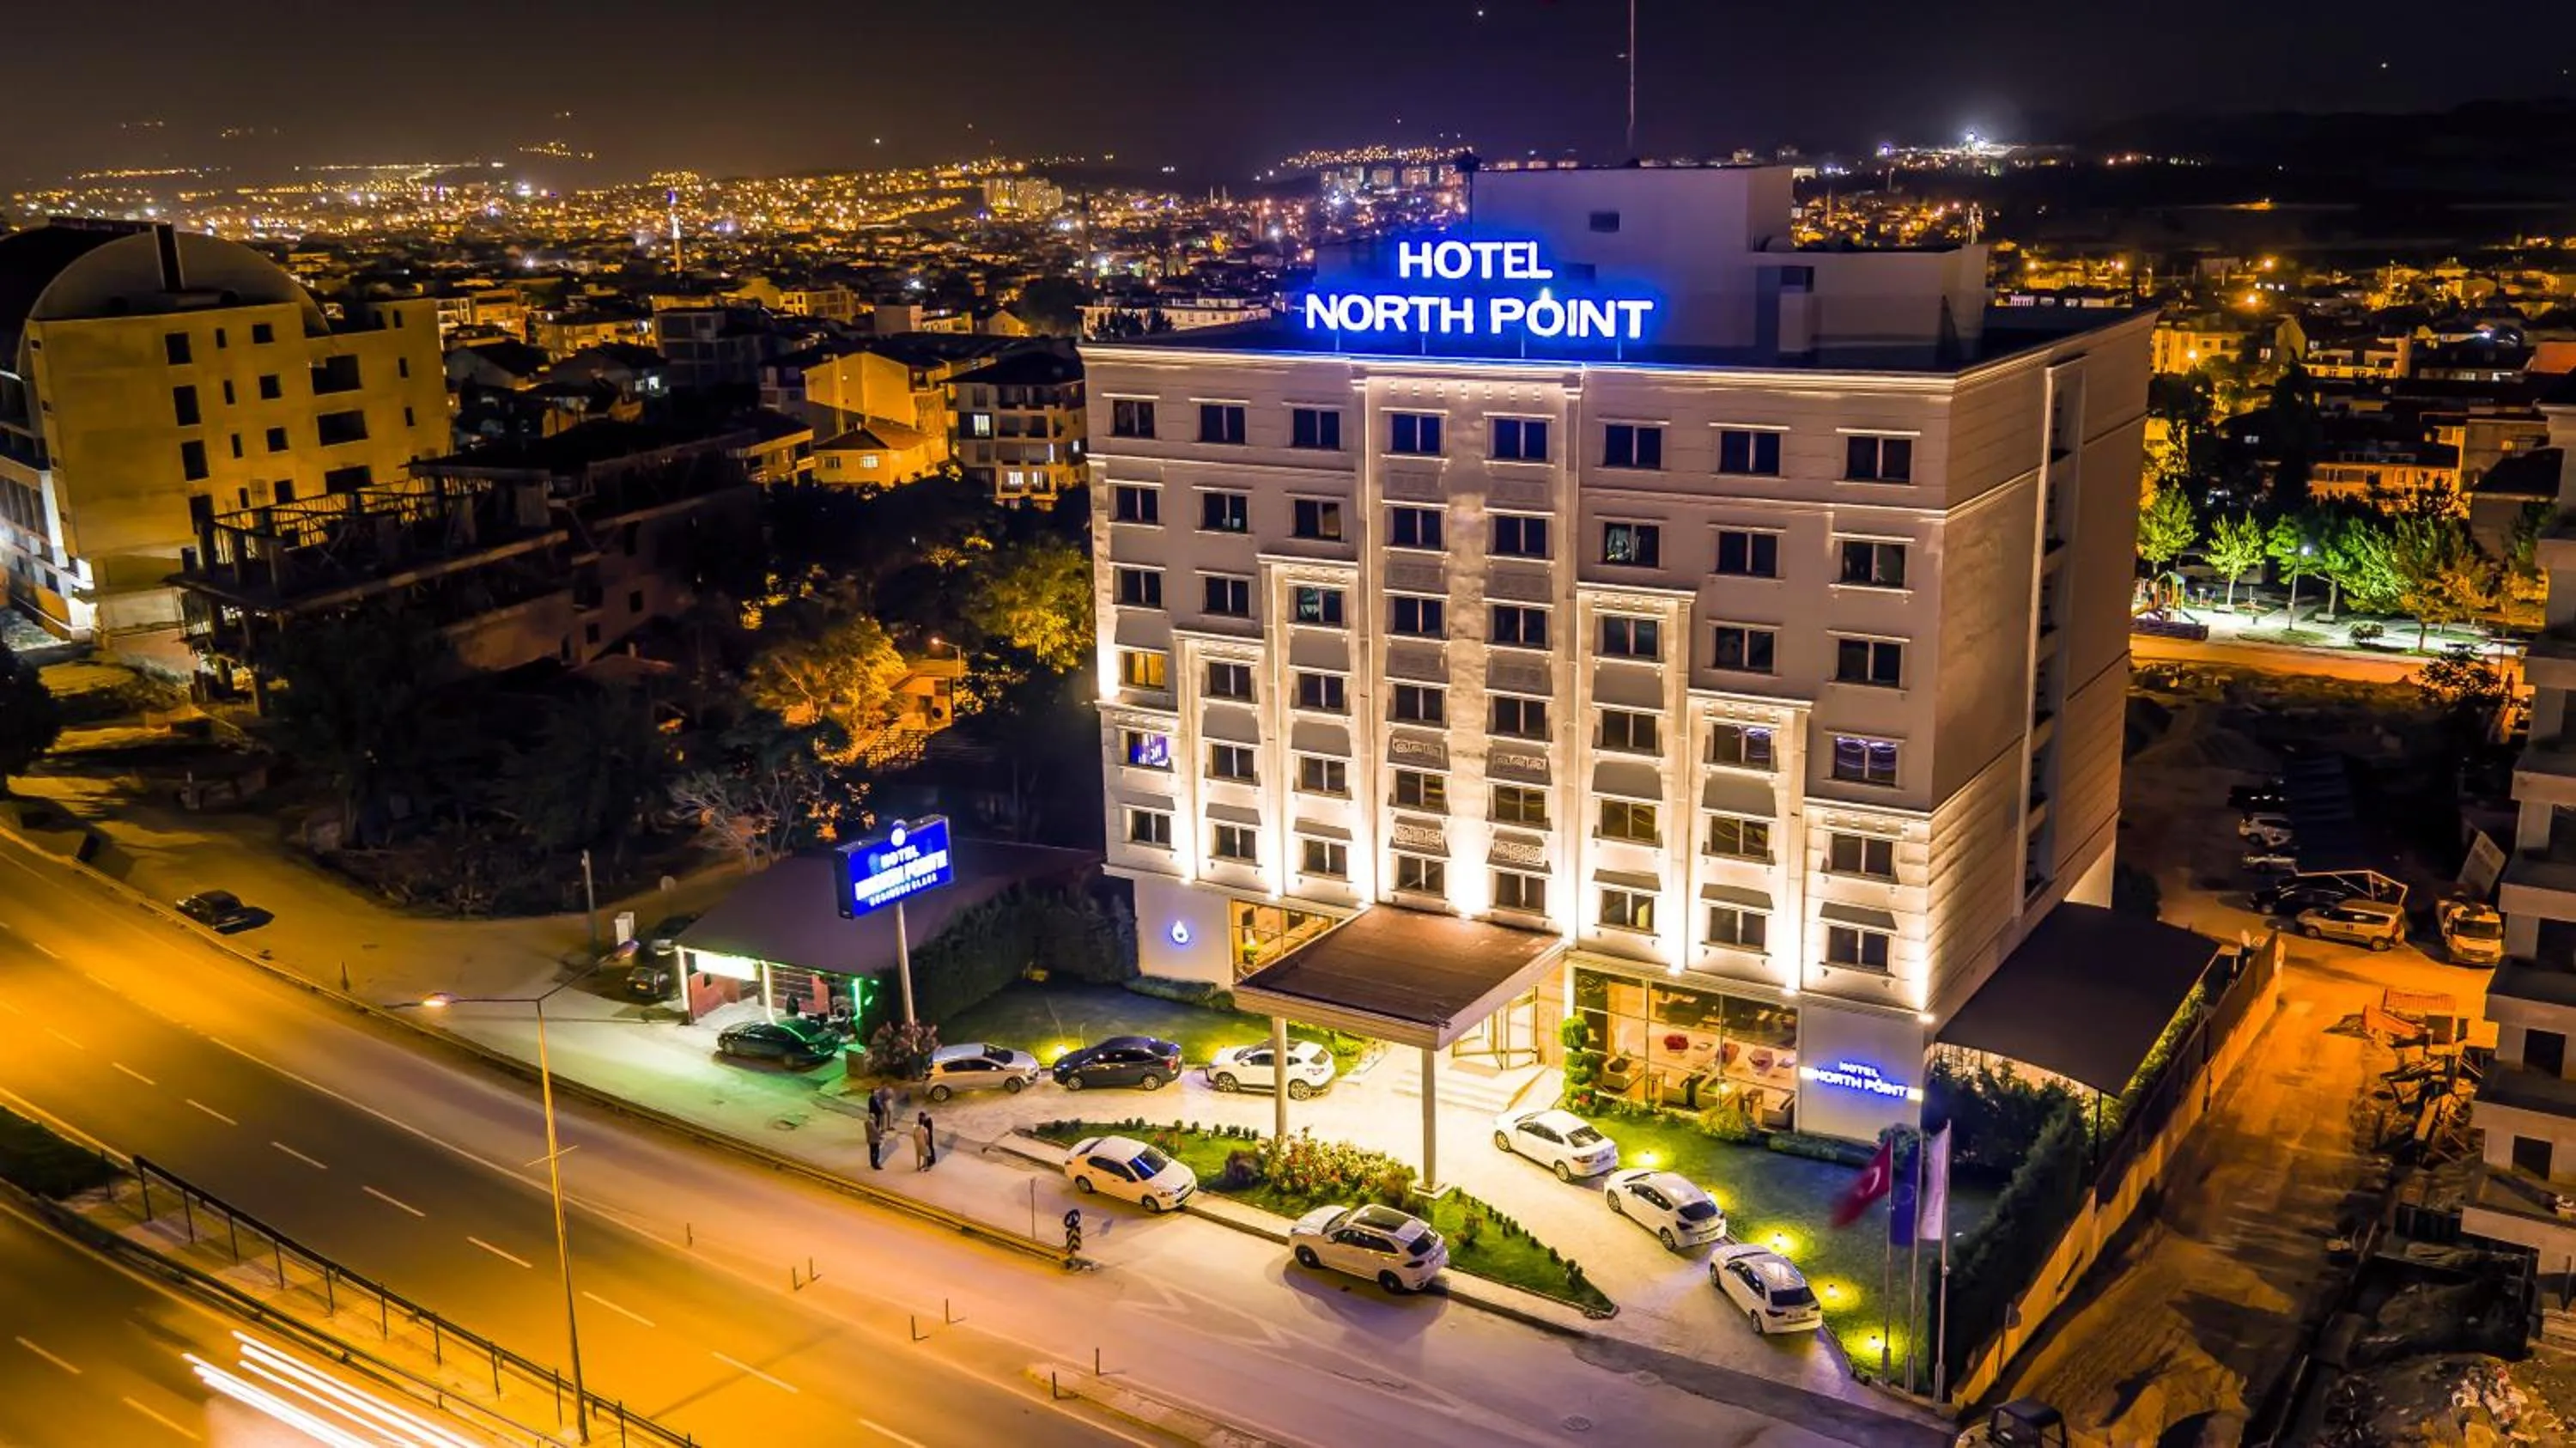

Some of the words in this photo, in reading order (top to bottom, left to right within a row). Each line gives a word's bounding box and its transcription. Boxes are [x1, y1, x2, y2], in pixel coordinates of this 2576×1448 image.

[1398, 240, 1553, 280] HOTEL
[1305, 293, 1475, 335] NORTH
[1489, 289, 1654, 339] POINT
[879, 844, 920, 870] HOTEL
[1815, 1069, 1862, 1089] NORTH
[1863, 1078, 1907, 1097] POINT
[1838, 1062, 1880, 1078] HOTEL
